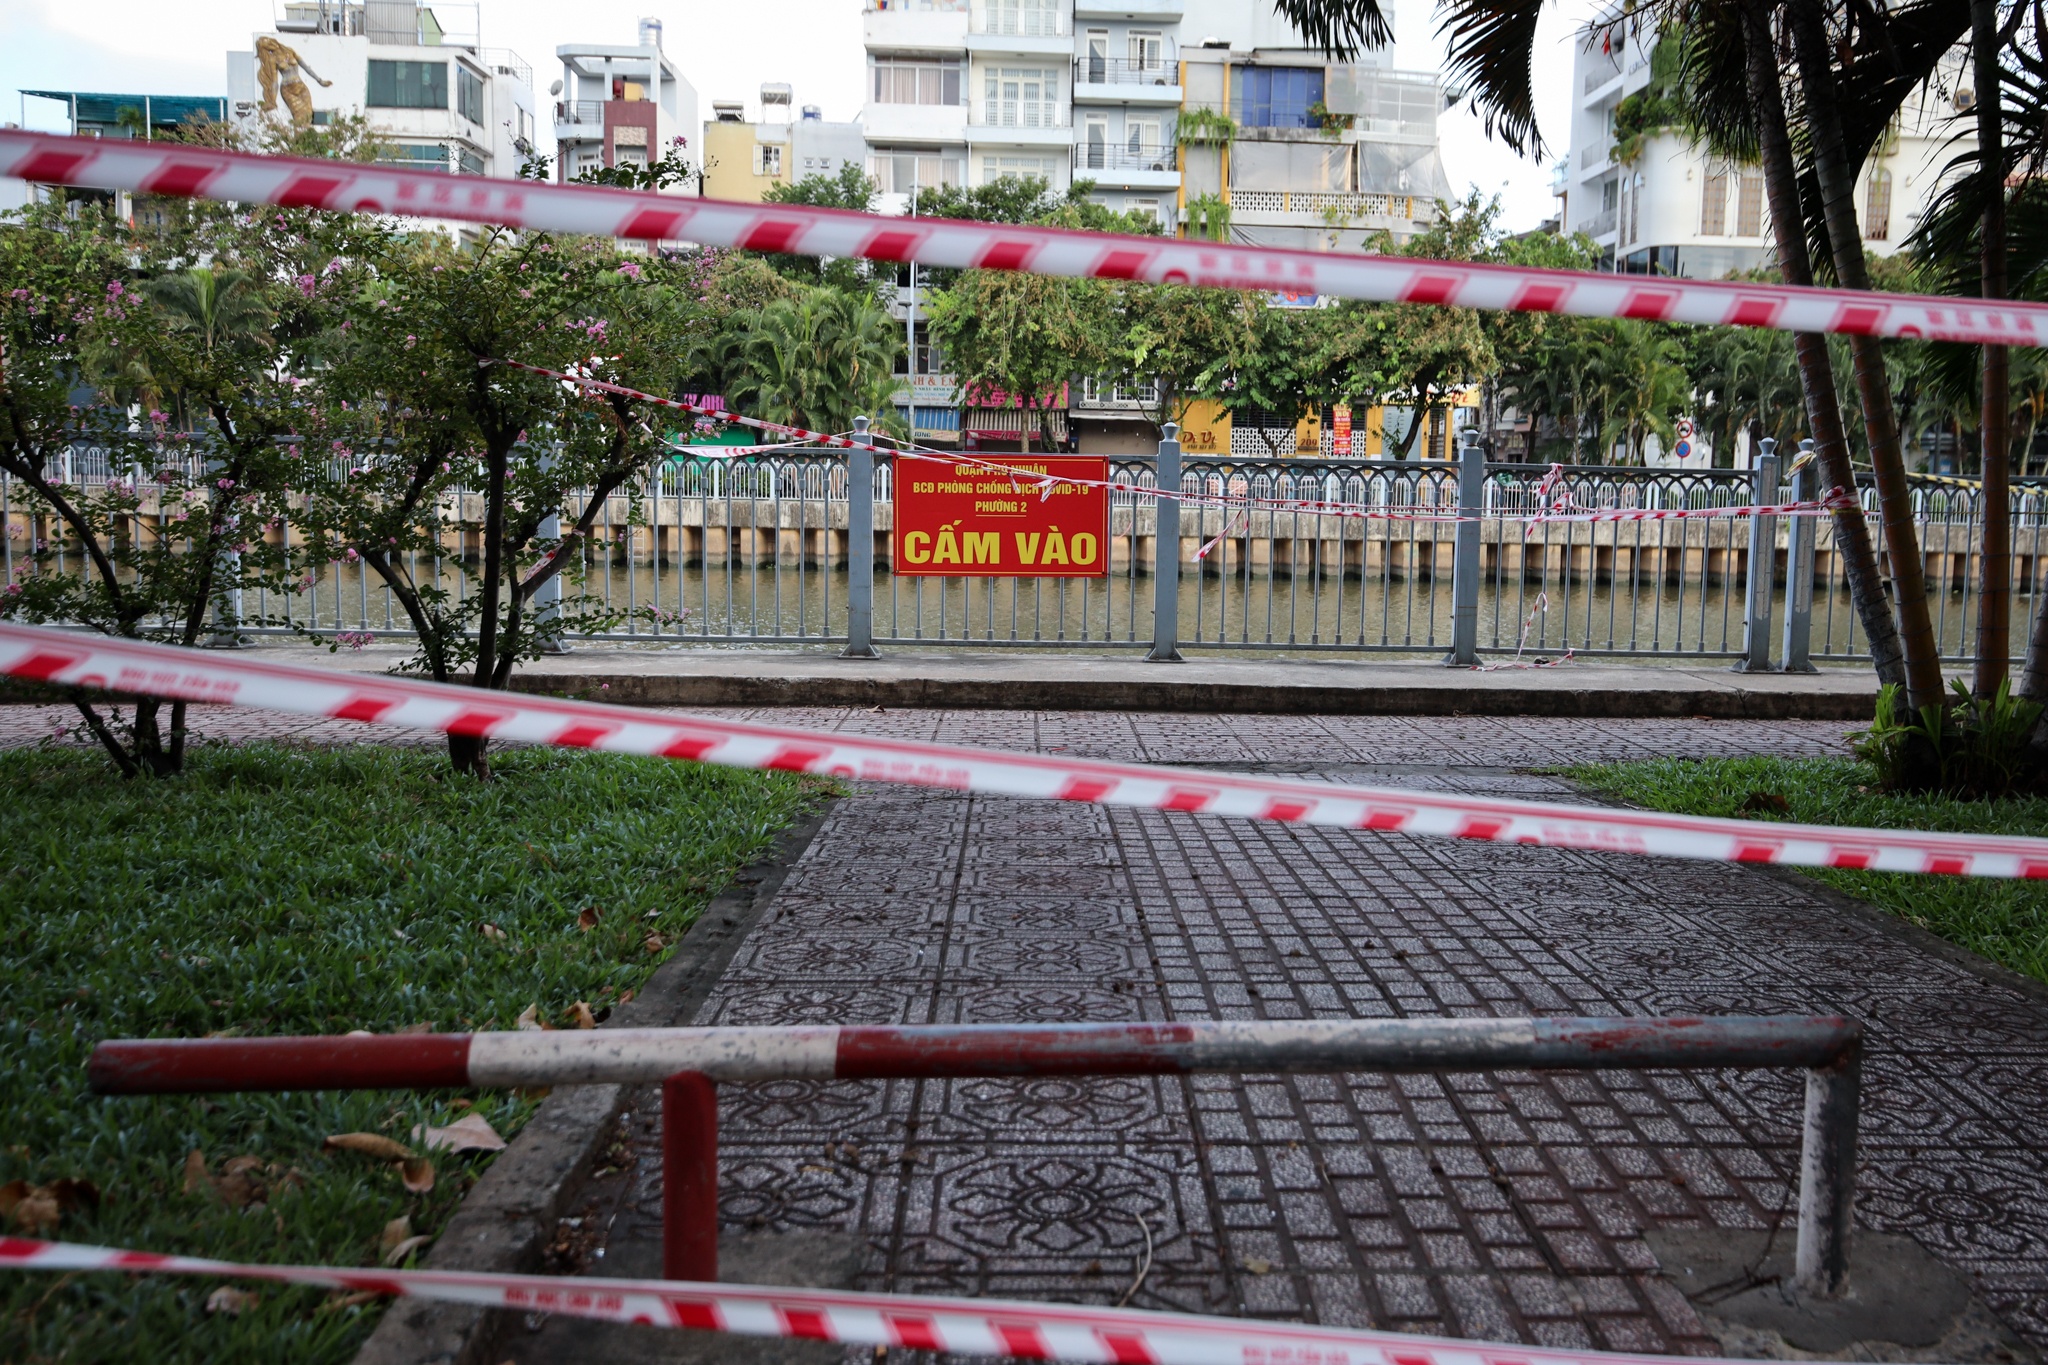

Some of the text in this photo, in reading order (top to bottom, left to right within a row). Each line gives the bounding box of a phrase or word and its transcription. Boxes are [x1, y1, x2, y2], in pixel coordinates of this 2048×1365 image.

[1301, 438, 1318, 446] 209
[913, 482, 934, 493] BCĐ
[937, 479, 972, 494] PHÒNG
[976, 478, 1012, 494] CHỐNG
[975, 499, 1027, 513] PHƯỜNG 2
[904, 520, 1097, 565] CẤM VÀO
